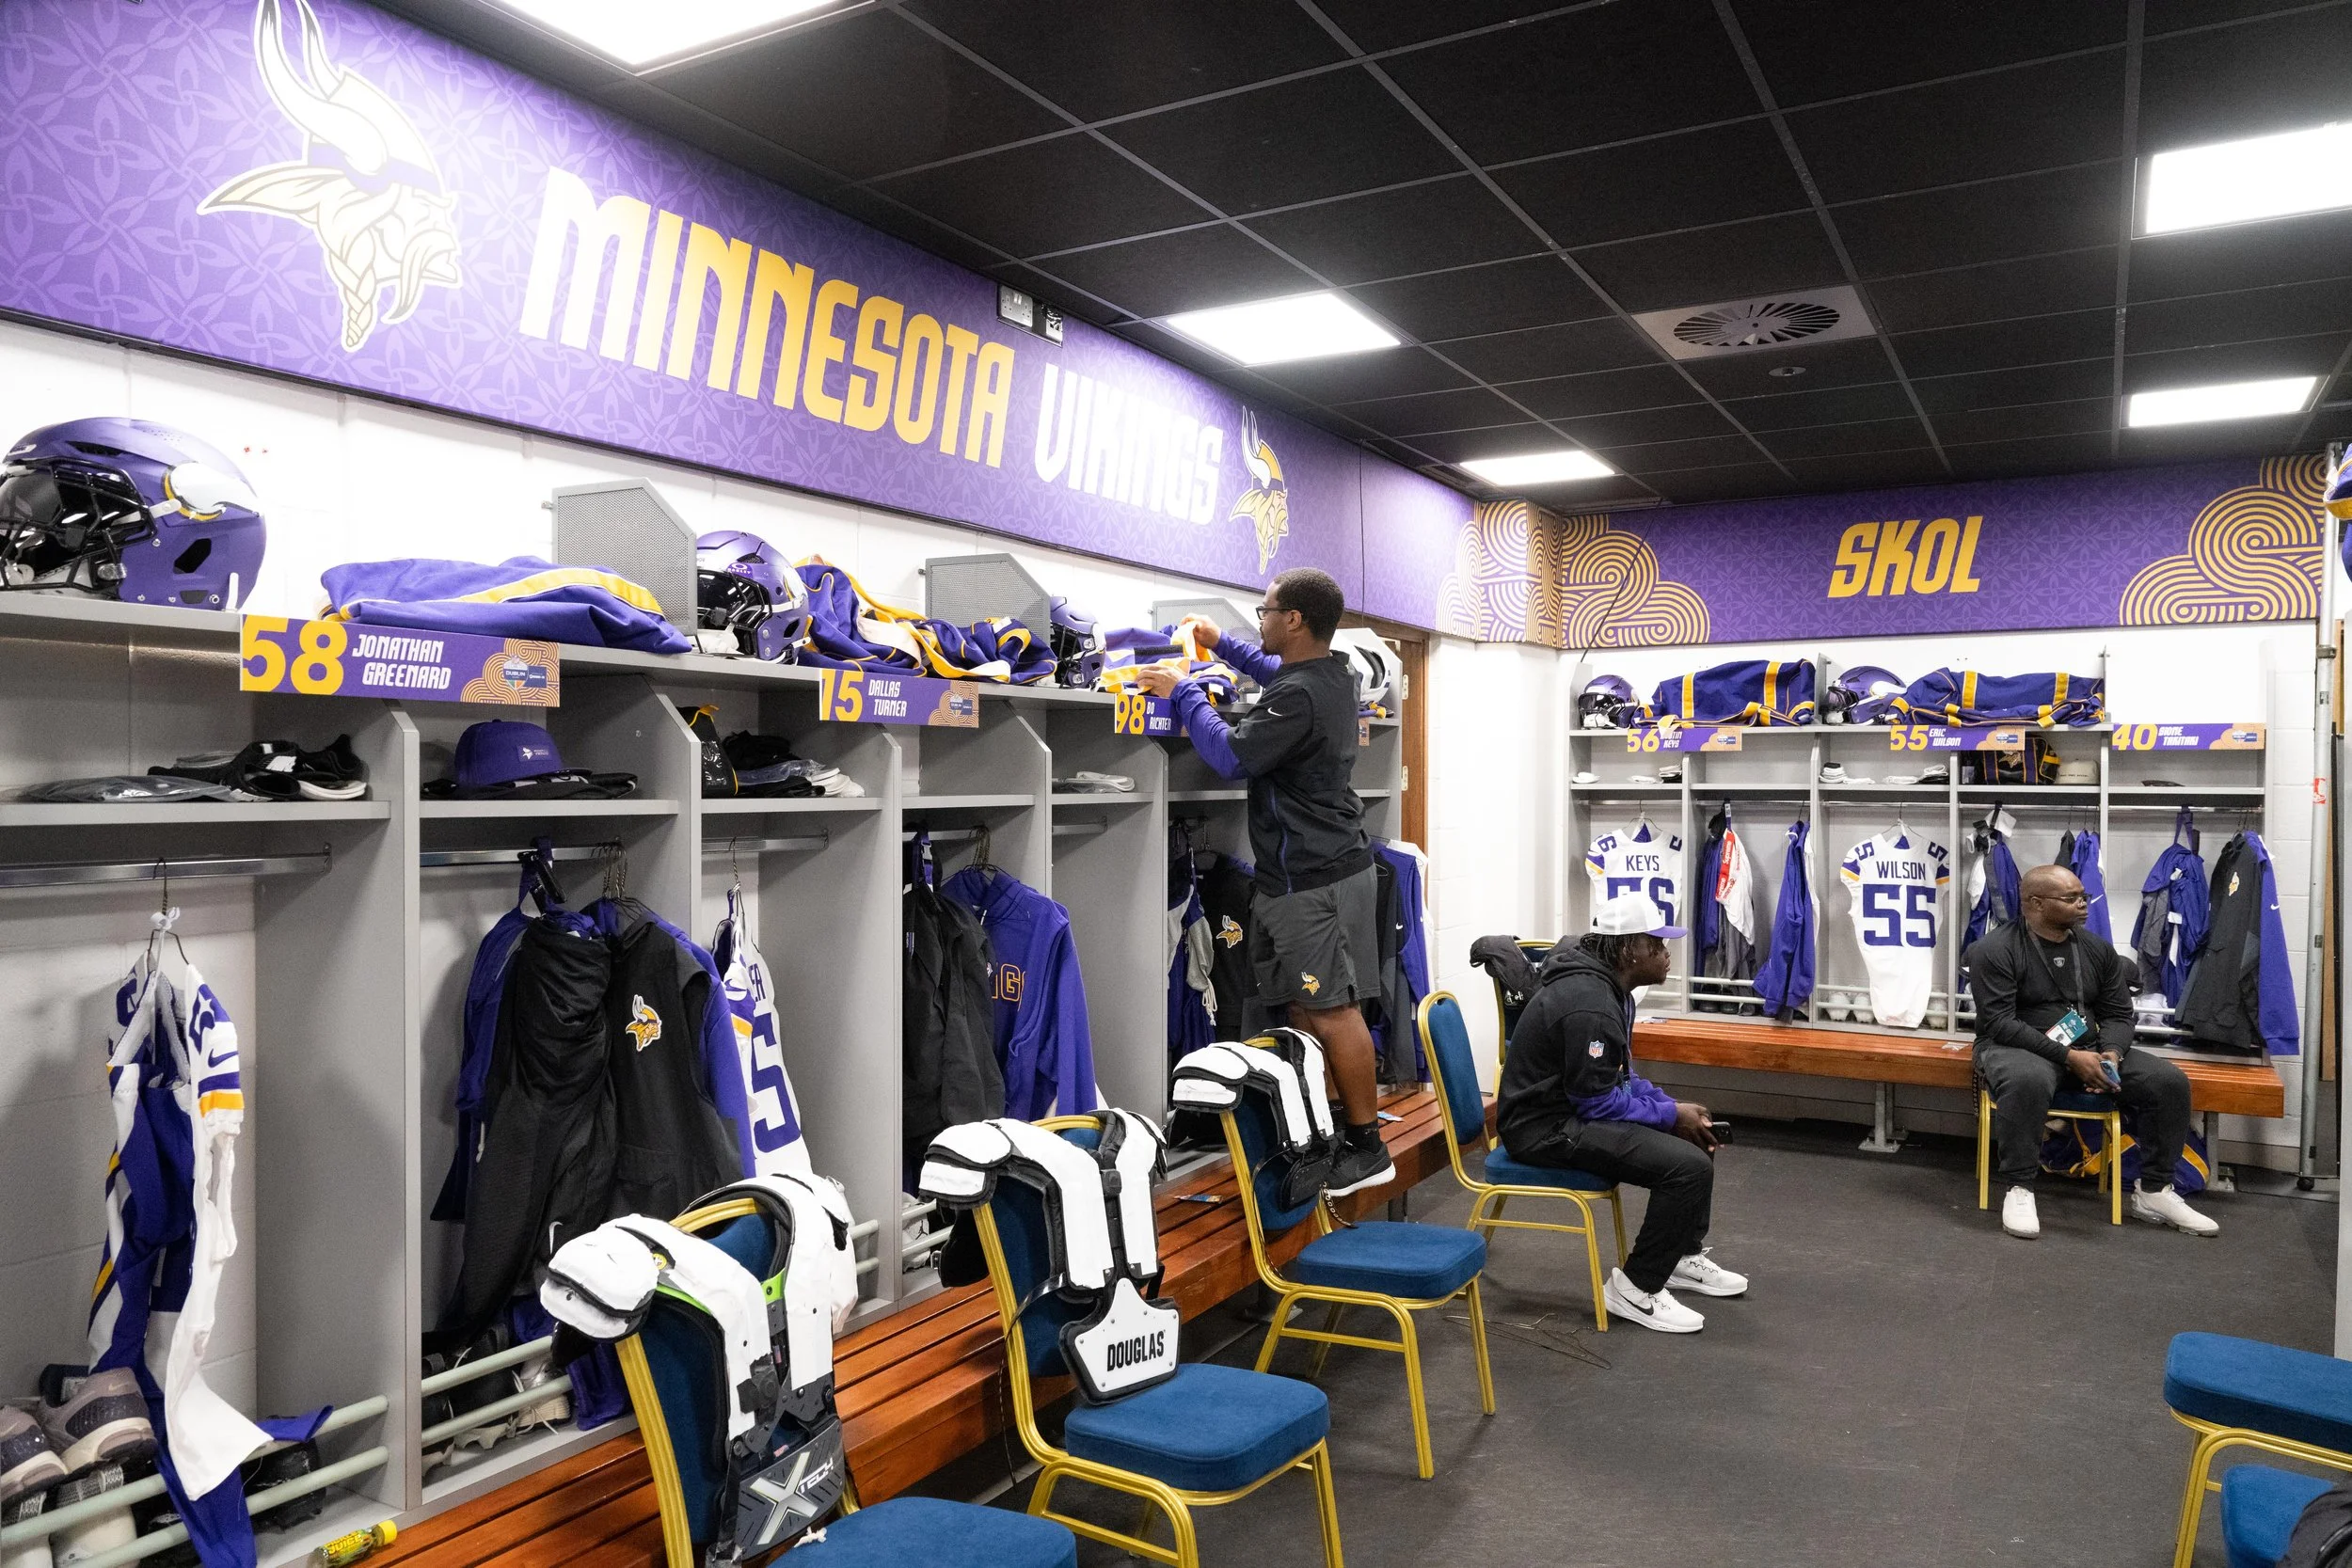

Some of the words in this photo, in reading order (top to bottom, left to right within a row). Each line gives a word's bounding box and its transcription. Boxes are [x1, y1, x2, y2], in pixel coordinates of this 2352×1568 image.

[520, 166, 1015, 468] MINNESOTA
[1036, 362, 1223, 524] VIKINGS
[1827, 516, 1983, 597] SKOL
[242, 614, 348, 695] 58
[353, 634, 444, 663] JONATHAN
[362, 662, 452, 689] GREENARD
[821, 668, 864, 722] 15
[868, 679, 900, 698] DALLAS
[873, 699, 907, 717] TURNER
[1117, 693, 1146, 735] 98
[1147, 702, 1155, 715] BO
[1150, 717, 1172, 731] RICHTER
[1930, 728, 1947, 737] ERIC
[1628, 729, 1660, 752] 56
[1663, 740, 1680, 749] KEYS
[1890, 725, 1930, 751] 55
[1932, 737, 1962, 747] WILSON
[2112, 723, 2158, 751] 40
[1626, 855, 1660, 872] KEYS
[1876, 861, 1927, 881] WILSON
[1863, 884, 1937, 948] 55
[1107, 1331, 1165, 1371] DOUGLAS
[328, 1533, 364, 1555] JUICE
